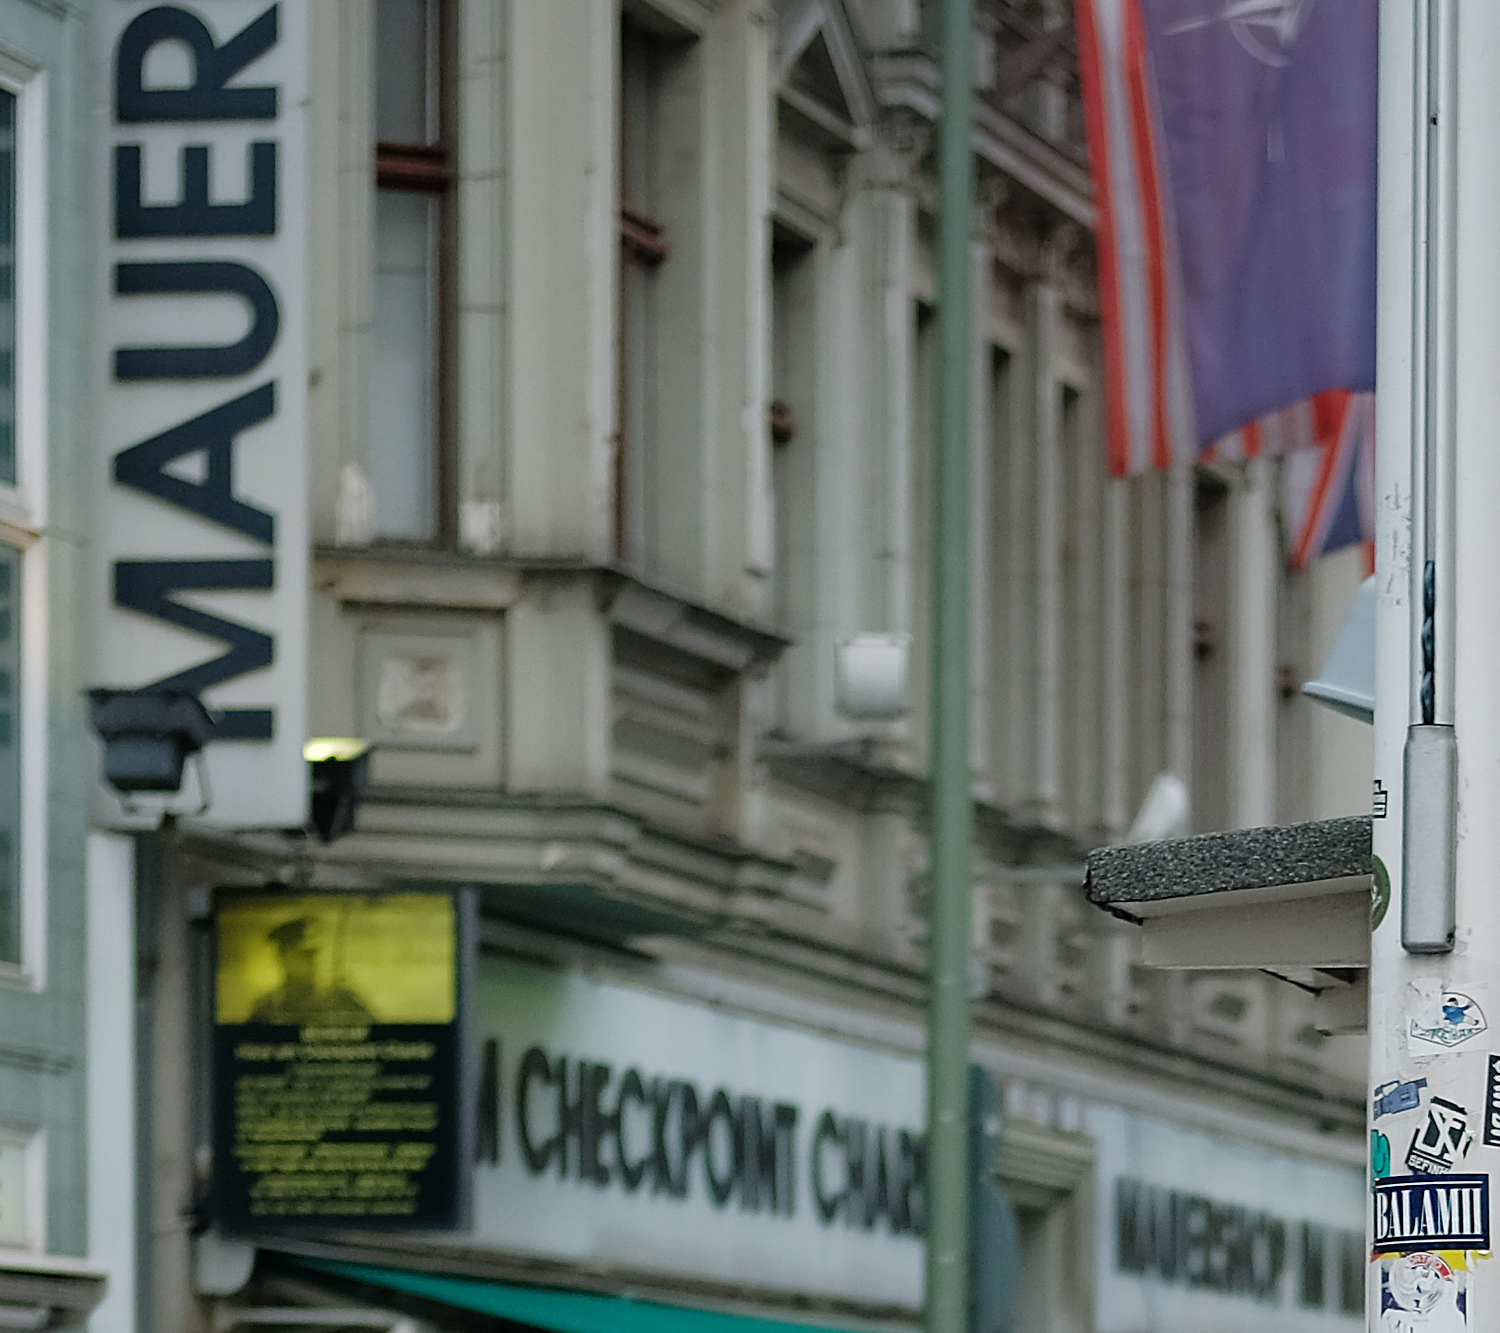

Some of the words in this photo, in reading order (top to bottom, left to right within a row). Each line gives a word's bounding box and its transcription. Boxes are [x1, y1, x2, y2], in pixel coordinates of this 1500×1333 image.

[109, 4, 286, 743] MAUER
[515, 1044, 800, 1215] CHECKPOINT
[1376, 1187, 1483, 1240] BALAMII
